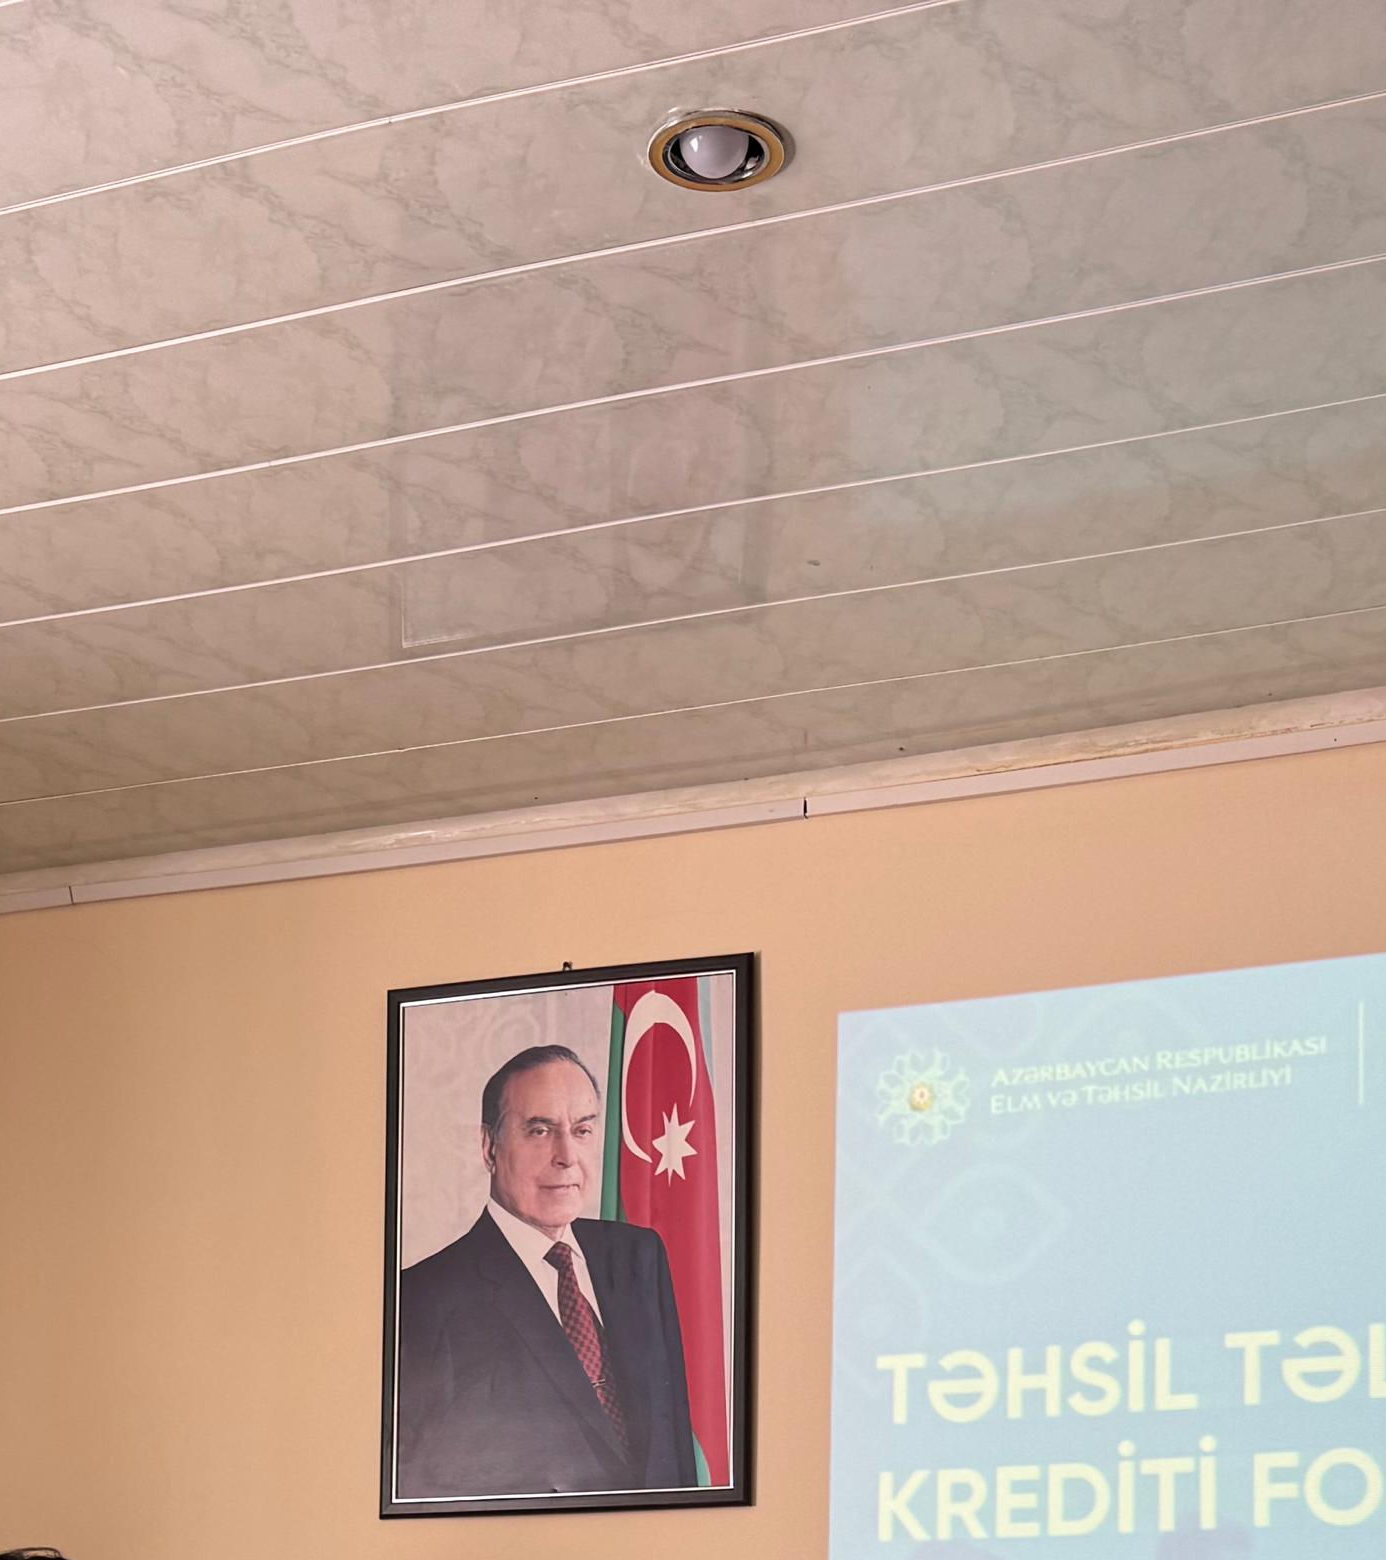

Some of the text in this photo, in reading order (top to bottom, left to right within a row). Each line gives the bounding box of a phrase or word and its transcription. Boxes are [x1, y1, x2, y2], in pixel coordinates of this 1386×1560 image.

[991, 1092, 1042, 1115] ELM
[876, 1319, 1199, 1425] TƏHSİL
[877, 1435, 1217, 1542] KREDİTİ
